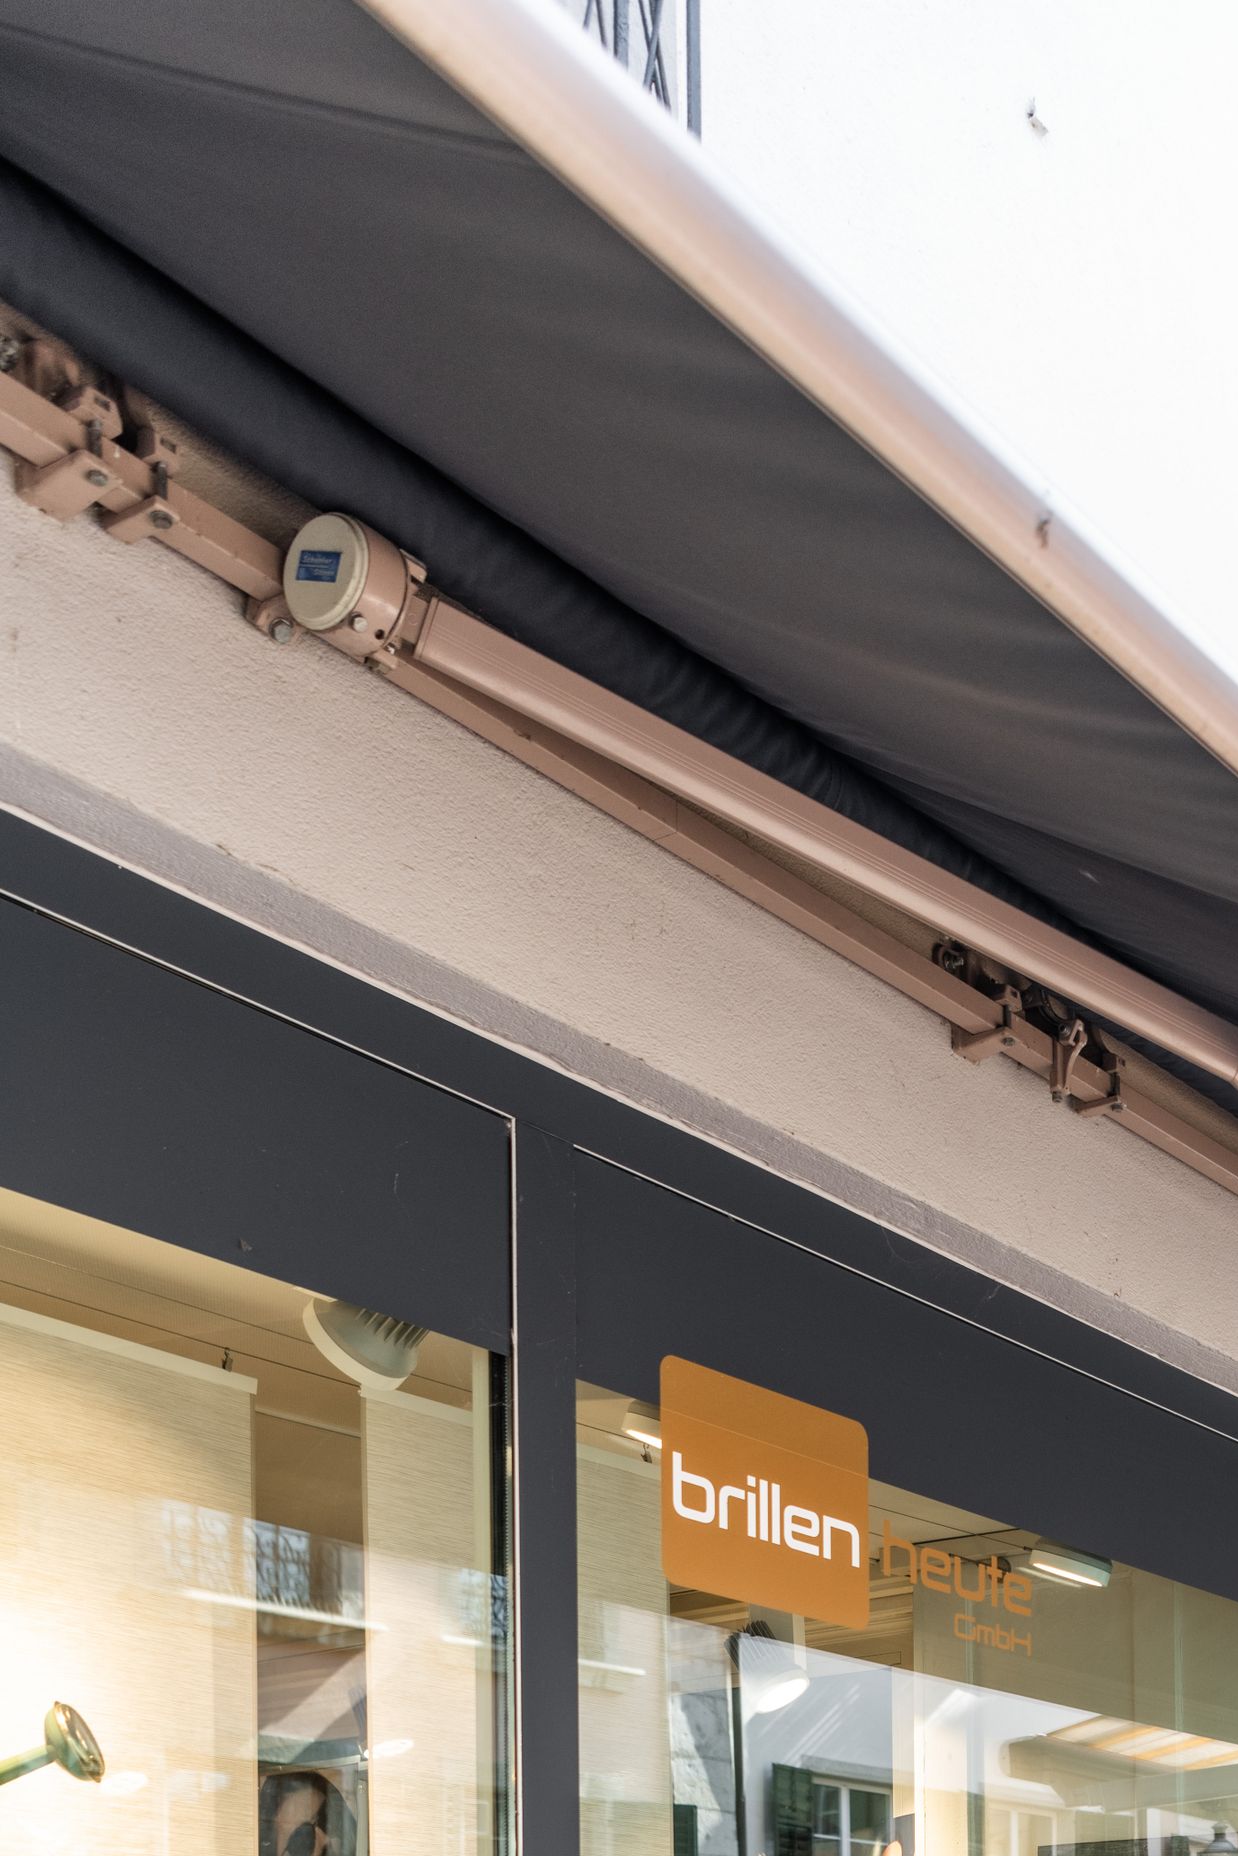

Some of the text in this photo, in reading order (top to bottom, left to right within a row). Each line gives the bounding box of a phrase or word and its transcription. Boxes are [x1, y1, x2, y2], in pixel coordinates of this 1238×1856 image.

[672, 1451, 1032, 1616] brillen heute
[953, 1614, 1032, 1656] GmbH
